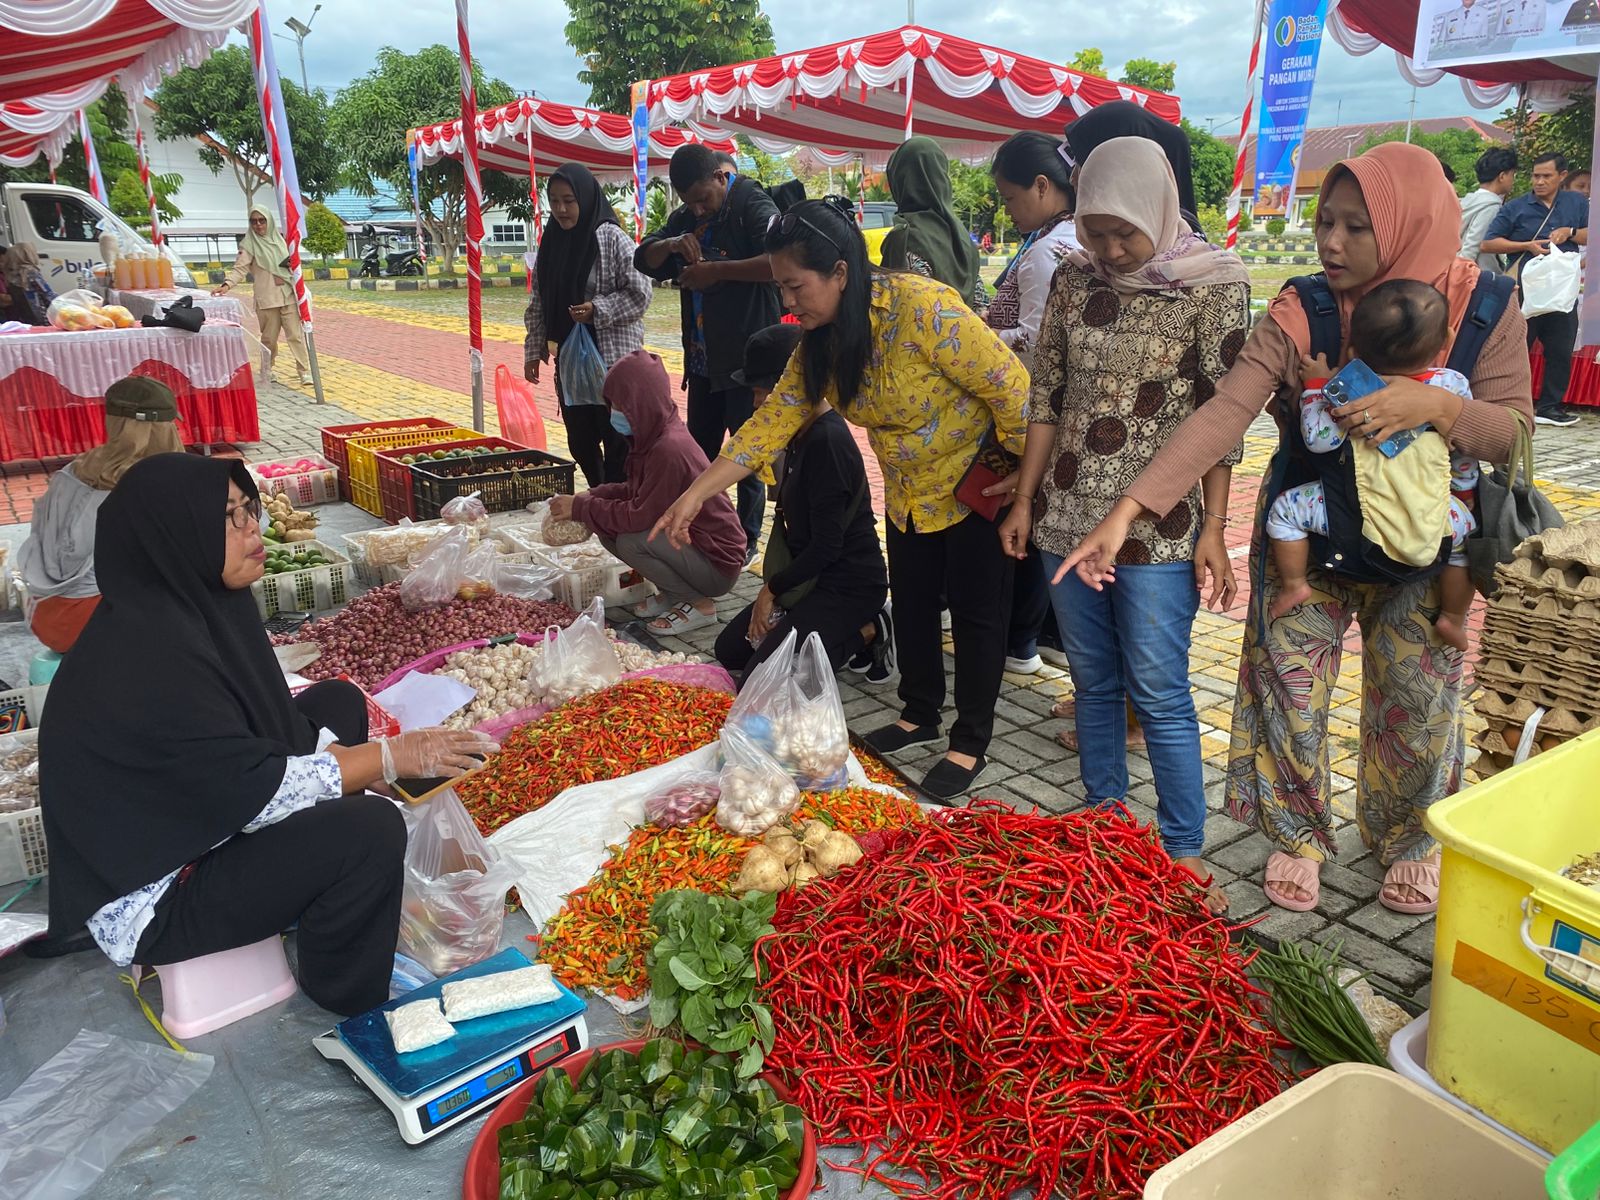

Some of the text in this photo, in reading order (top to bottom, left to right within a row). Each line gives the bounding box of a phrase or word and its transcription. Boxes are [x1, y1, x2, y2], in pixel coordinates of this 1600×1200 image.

[1298, 15, 1318, 24] Badan
[1282, 55, 1312, 70] GERAKAN
[1269, 71, 1297, 85] PANGAN
